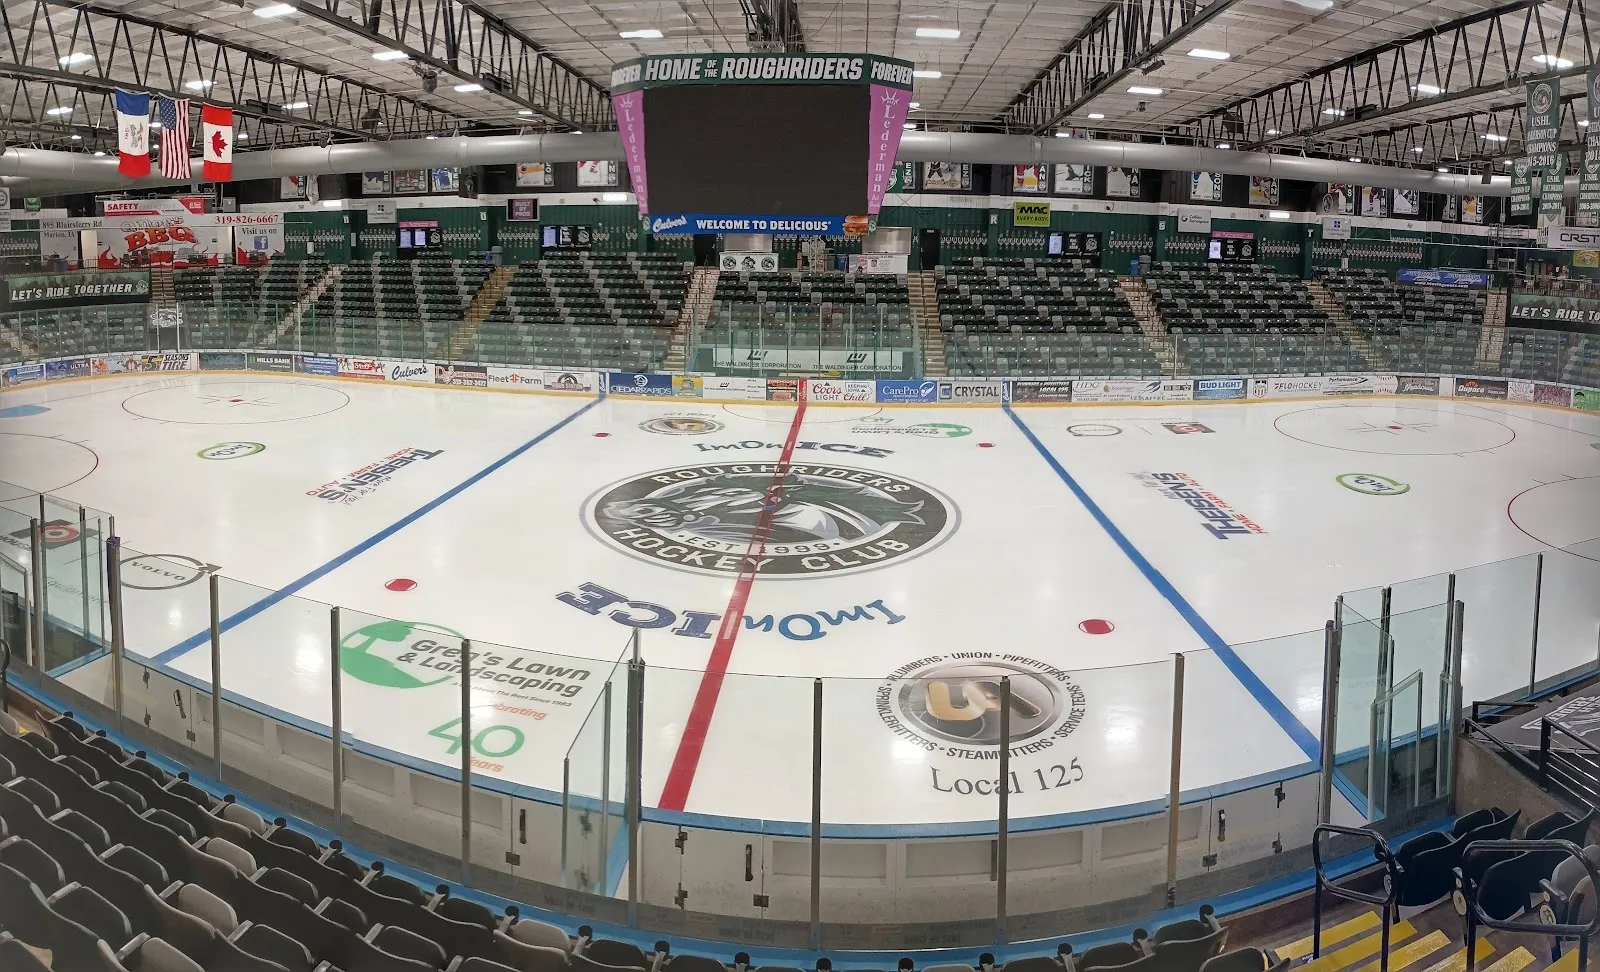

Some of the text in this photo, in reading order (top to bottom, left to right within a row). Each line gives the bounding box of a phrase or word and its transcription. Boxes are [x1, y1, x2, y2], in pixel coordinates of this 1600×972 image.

[645, 58, 703, 81] HOME
[706, 59, 717, 68] OF
[720, 57, 864, 80] ROUGHRIDERS
[704, 68, 718, 78] THE
[871, 62, 914, 85] FOREVER
[1531, 115, 1551, 127] USHL
[624, 109, 645, 193] Lederman
[872, 104, 896, 193] Lederman
[215, 214, 279, 224] 319-826-6667
[1019, 206, 1048, 214] MAC
[42, 220, 103, 230] 895 Blairsferry Rd
[652, 215, 689, 233] Culver's
[696, 219, 750, 230] WELCOME
[752, 219, 767, 230] TO
[990, 215, 998, 224] R
[124, 227, 198, 252] BBQ
[242, 227, 257, 235] Visit
[268, 227, 278, 235] on
[1307, 229, 1314, 237] T
[1560, 233, 1600, 243] CRST
[11, 283, 133, 301] LET'S RIDE TOGETHER
[1512, 305, 1585, 320] LET'S RIDE
[391, 363, 428, 380] Culver's
[488, 374, 509, 383] Fleet
[520, 377, 542, 385] Farm
[812, 383, 842, 394] Coors
[882, 385, 919, 395] CarePro
[954, 386, 999, 397] CRYSTAL
[1200, 382, 1218, 390] BUD
[1457, 385, 1485, 394] Dupaco
[692, 440, 895, 458] ImOn ICE
[317, 449, 445, 501] THEISEN'S
[654, 464, 911, 493] ROUGHRIDERS
[1174, 472, 1204, 488] AUTO
[305, 480, 340, 496] AUTO
[1151, 472, 1253, 540] THEISEN'S
[1200, 491, 1232, 509] FARM
[1230, 513, 1268, 534] HOME
[612, 527, 911, 572] HOCKEY CLUB
[684, 536, 741, 551] EST
[131, 561, 186, 582] VOLVO
[555, 581, 906, 641] ICE ImOn
[396, 651, 584, 698] & Landscaping
[507, 657, 591, 681] Lawn
[887, 651, 1070, 682] PLUMBERS UNION PIPEFITTERS
[511, 692, 529, 700] Rest
[529, 696, 551, 704] Since
[551, 699, 573, 707] 1983
[1053, 684, 1086, 739] SERVICE TECHS
[875, 686, 1054, 760] SPRINKLERFITTERS STEAMITTERS
[427, 717, 525, 758] 40
[1033, 756, 1085, 793] 125
